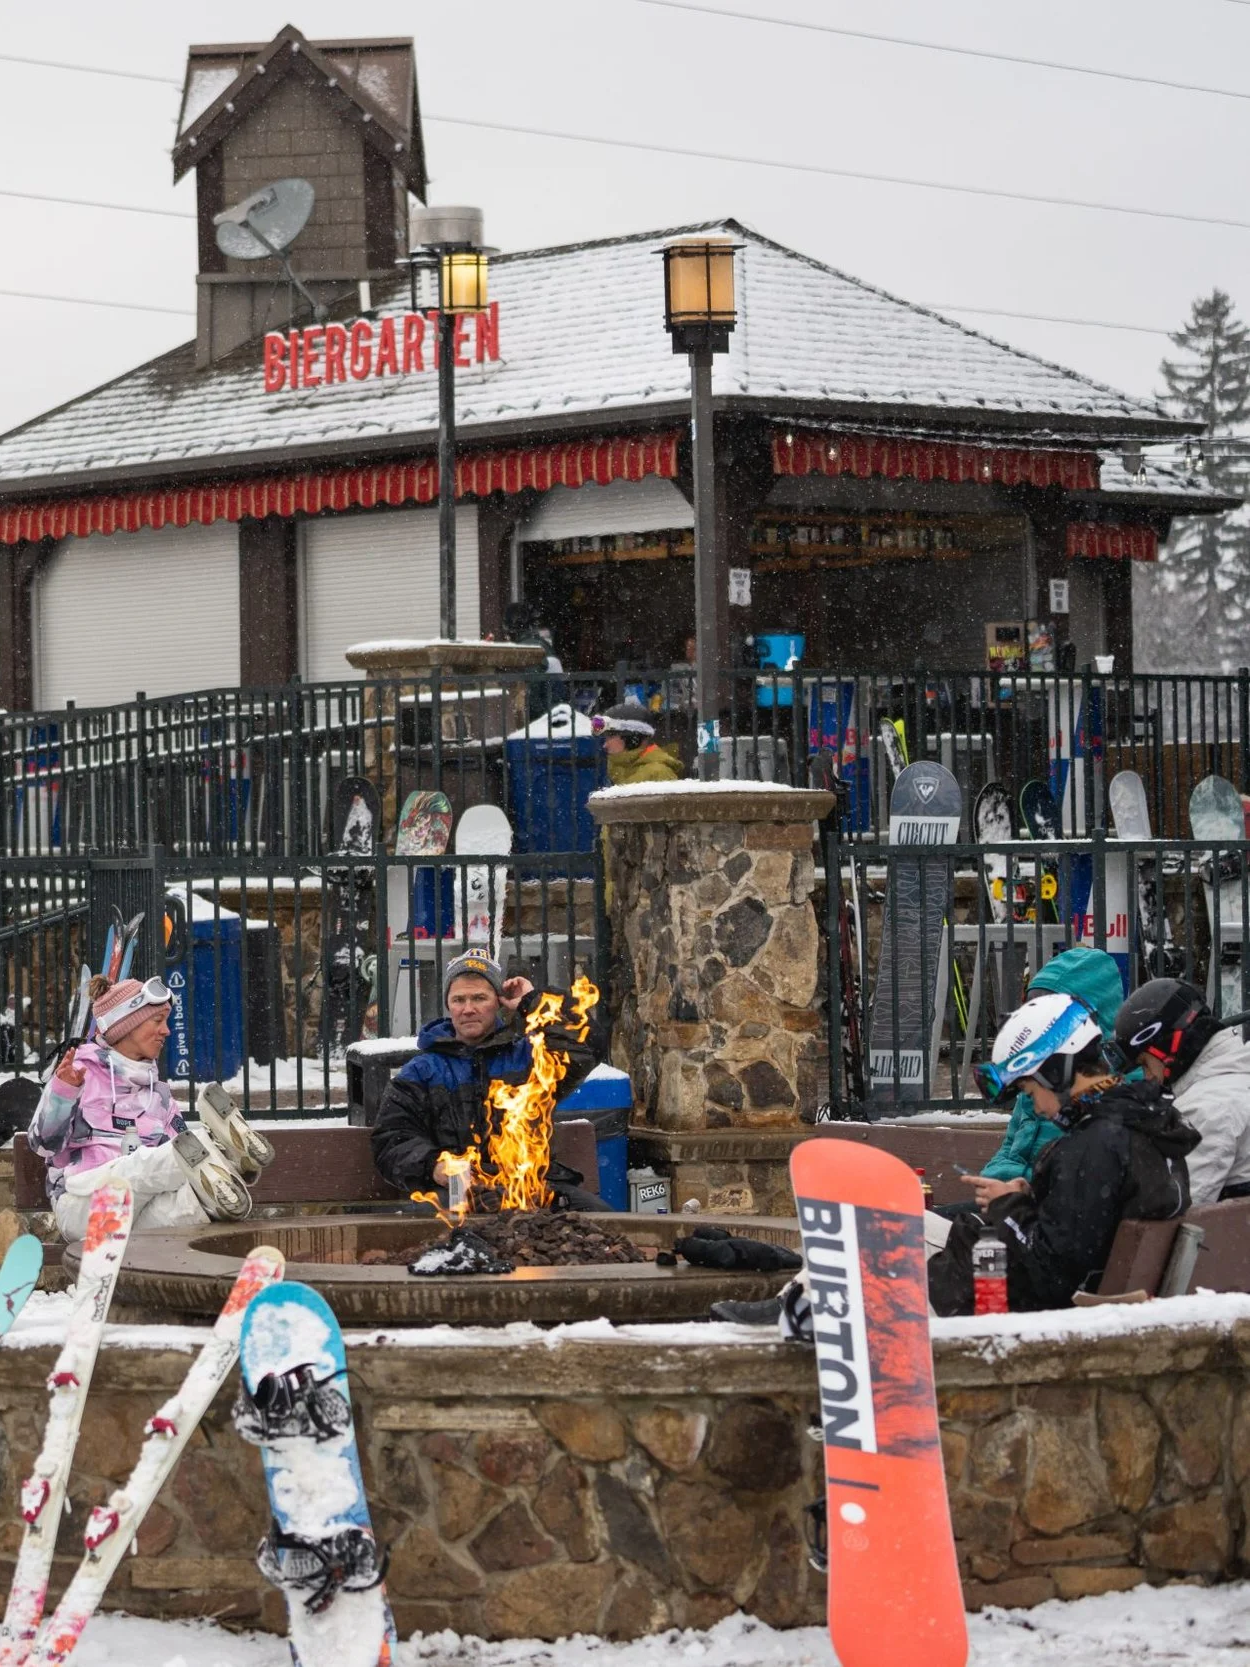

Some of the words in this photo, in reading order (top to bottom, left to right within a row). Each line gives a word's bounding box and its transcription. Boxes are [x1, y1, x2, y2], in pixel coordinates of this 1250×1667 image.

[264, 302, 499, 393] BIERGARTEN
[897, 822, 949, 845] CIRCUIT
[174, 993, 184, 1020] back
[175, 1021, 184, 1030] it
[176, 1033, 189, 1056] give
[873, 1055, 922, 1078] CIRUIT
[796, 1197, 862, 1450] BURTON
